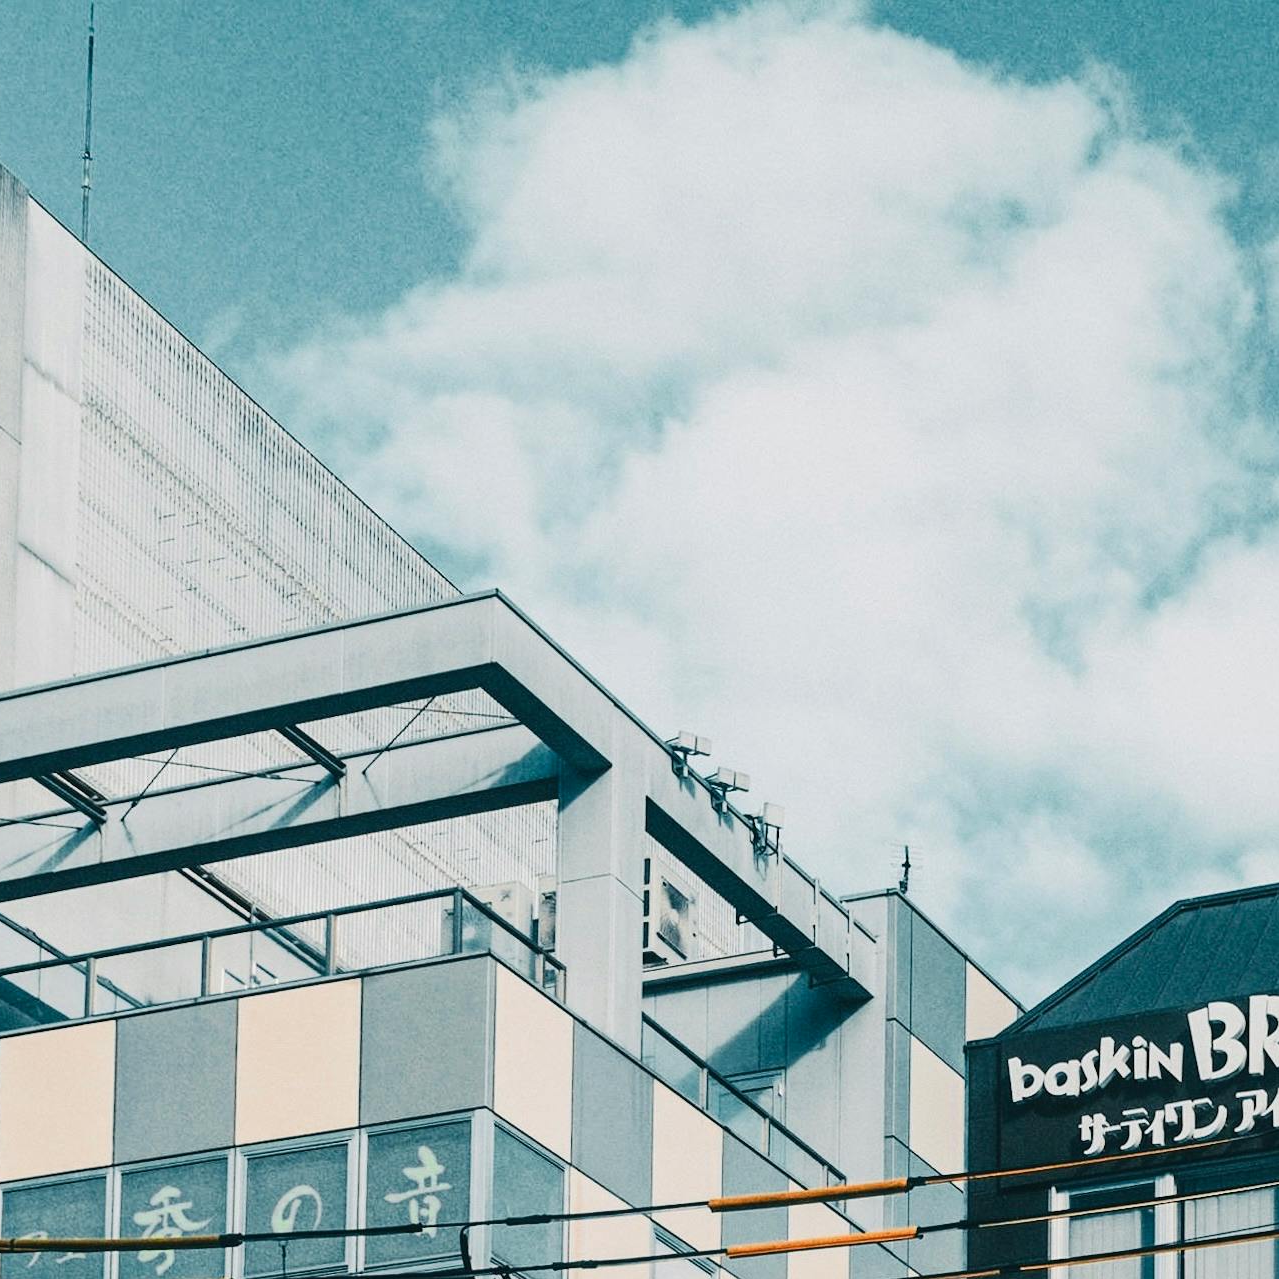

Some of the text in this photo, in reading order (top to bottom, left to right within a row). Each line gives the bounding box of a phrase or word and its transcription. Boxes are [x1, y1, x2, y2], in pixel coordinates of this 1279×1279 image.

[1008, 1036, 1184, 1103] baskin
[1078, 1097, 1227, 1156] サーティワン
